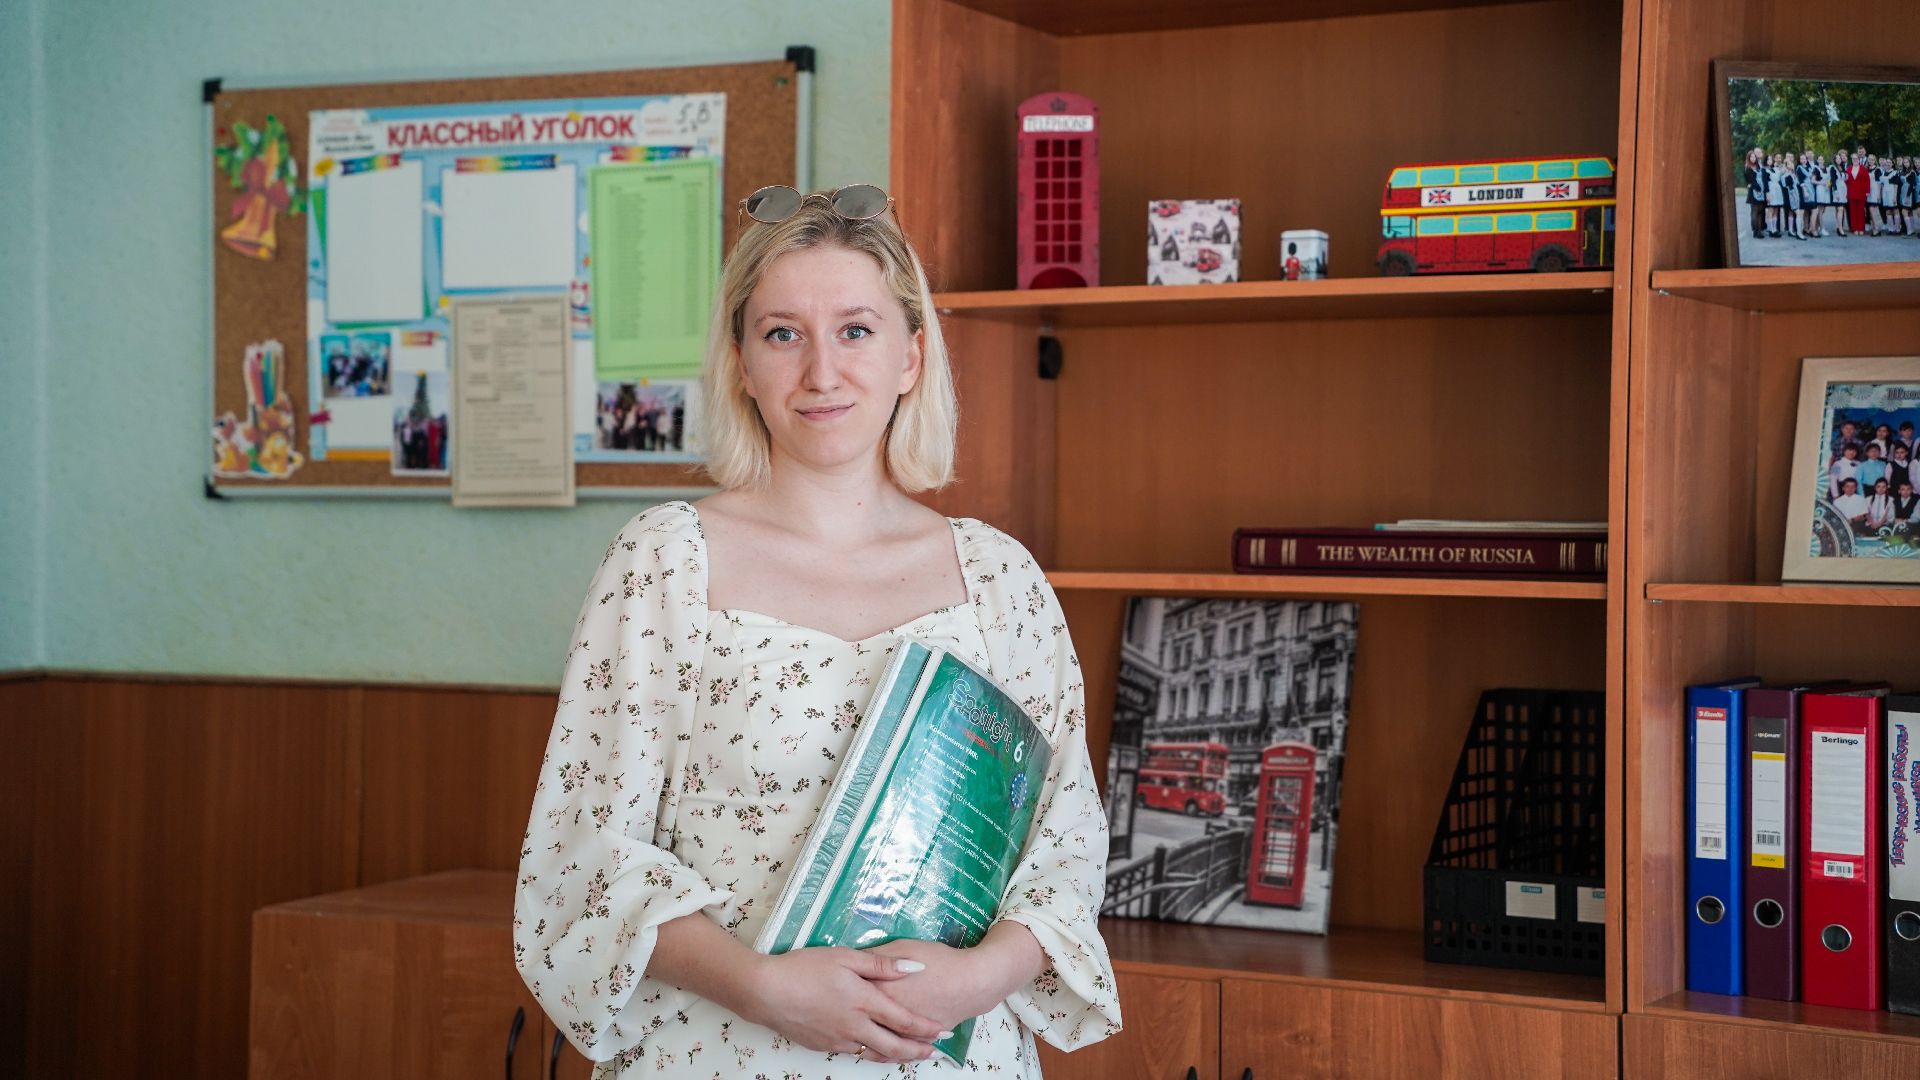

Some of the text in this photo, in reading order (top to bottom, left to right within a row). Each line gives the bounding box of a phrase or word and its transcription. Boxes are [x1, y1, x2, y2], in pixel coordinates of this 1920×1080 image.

[387, 113, 525, 146] КЛАССНЫЙ
[532, 114, 634, 141] УГОЛОК
[1027, 117, 1090, 131] TELEPHONE
[1468, 187, 1525, 201] LONDON
[1317, 545, 1535, 564] THE WEALTH OF RUSSIA
[948, 678, 1013, 752] Spotlight
[1821, 736, 1859, 746] Berlingo
[1013, 740, 1025, 762] 6
